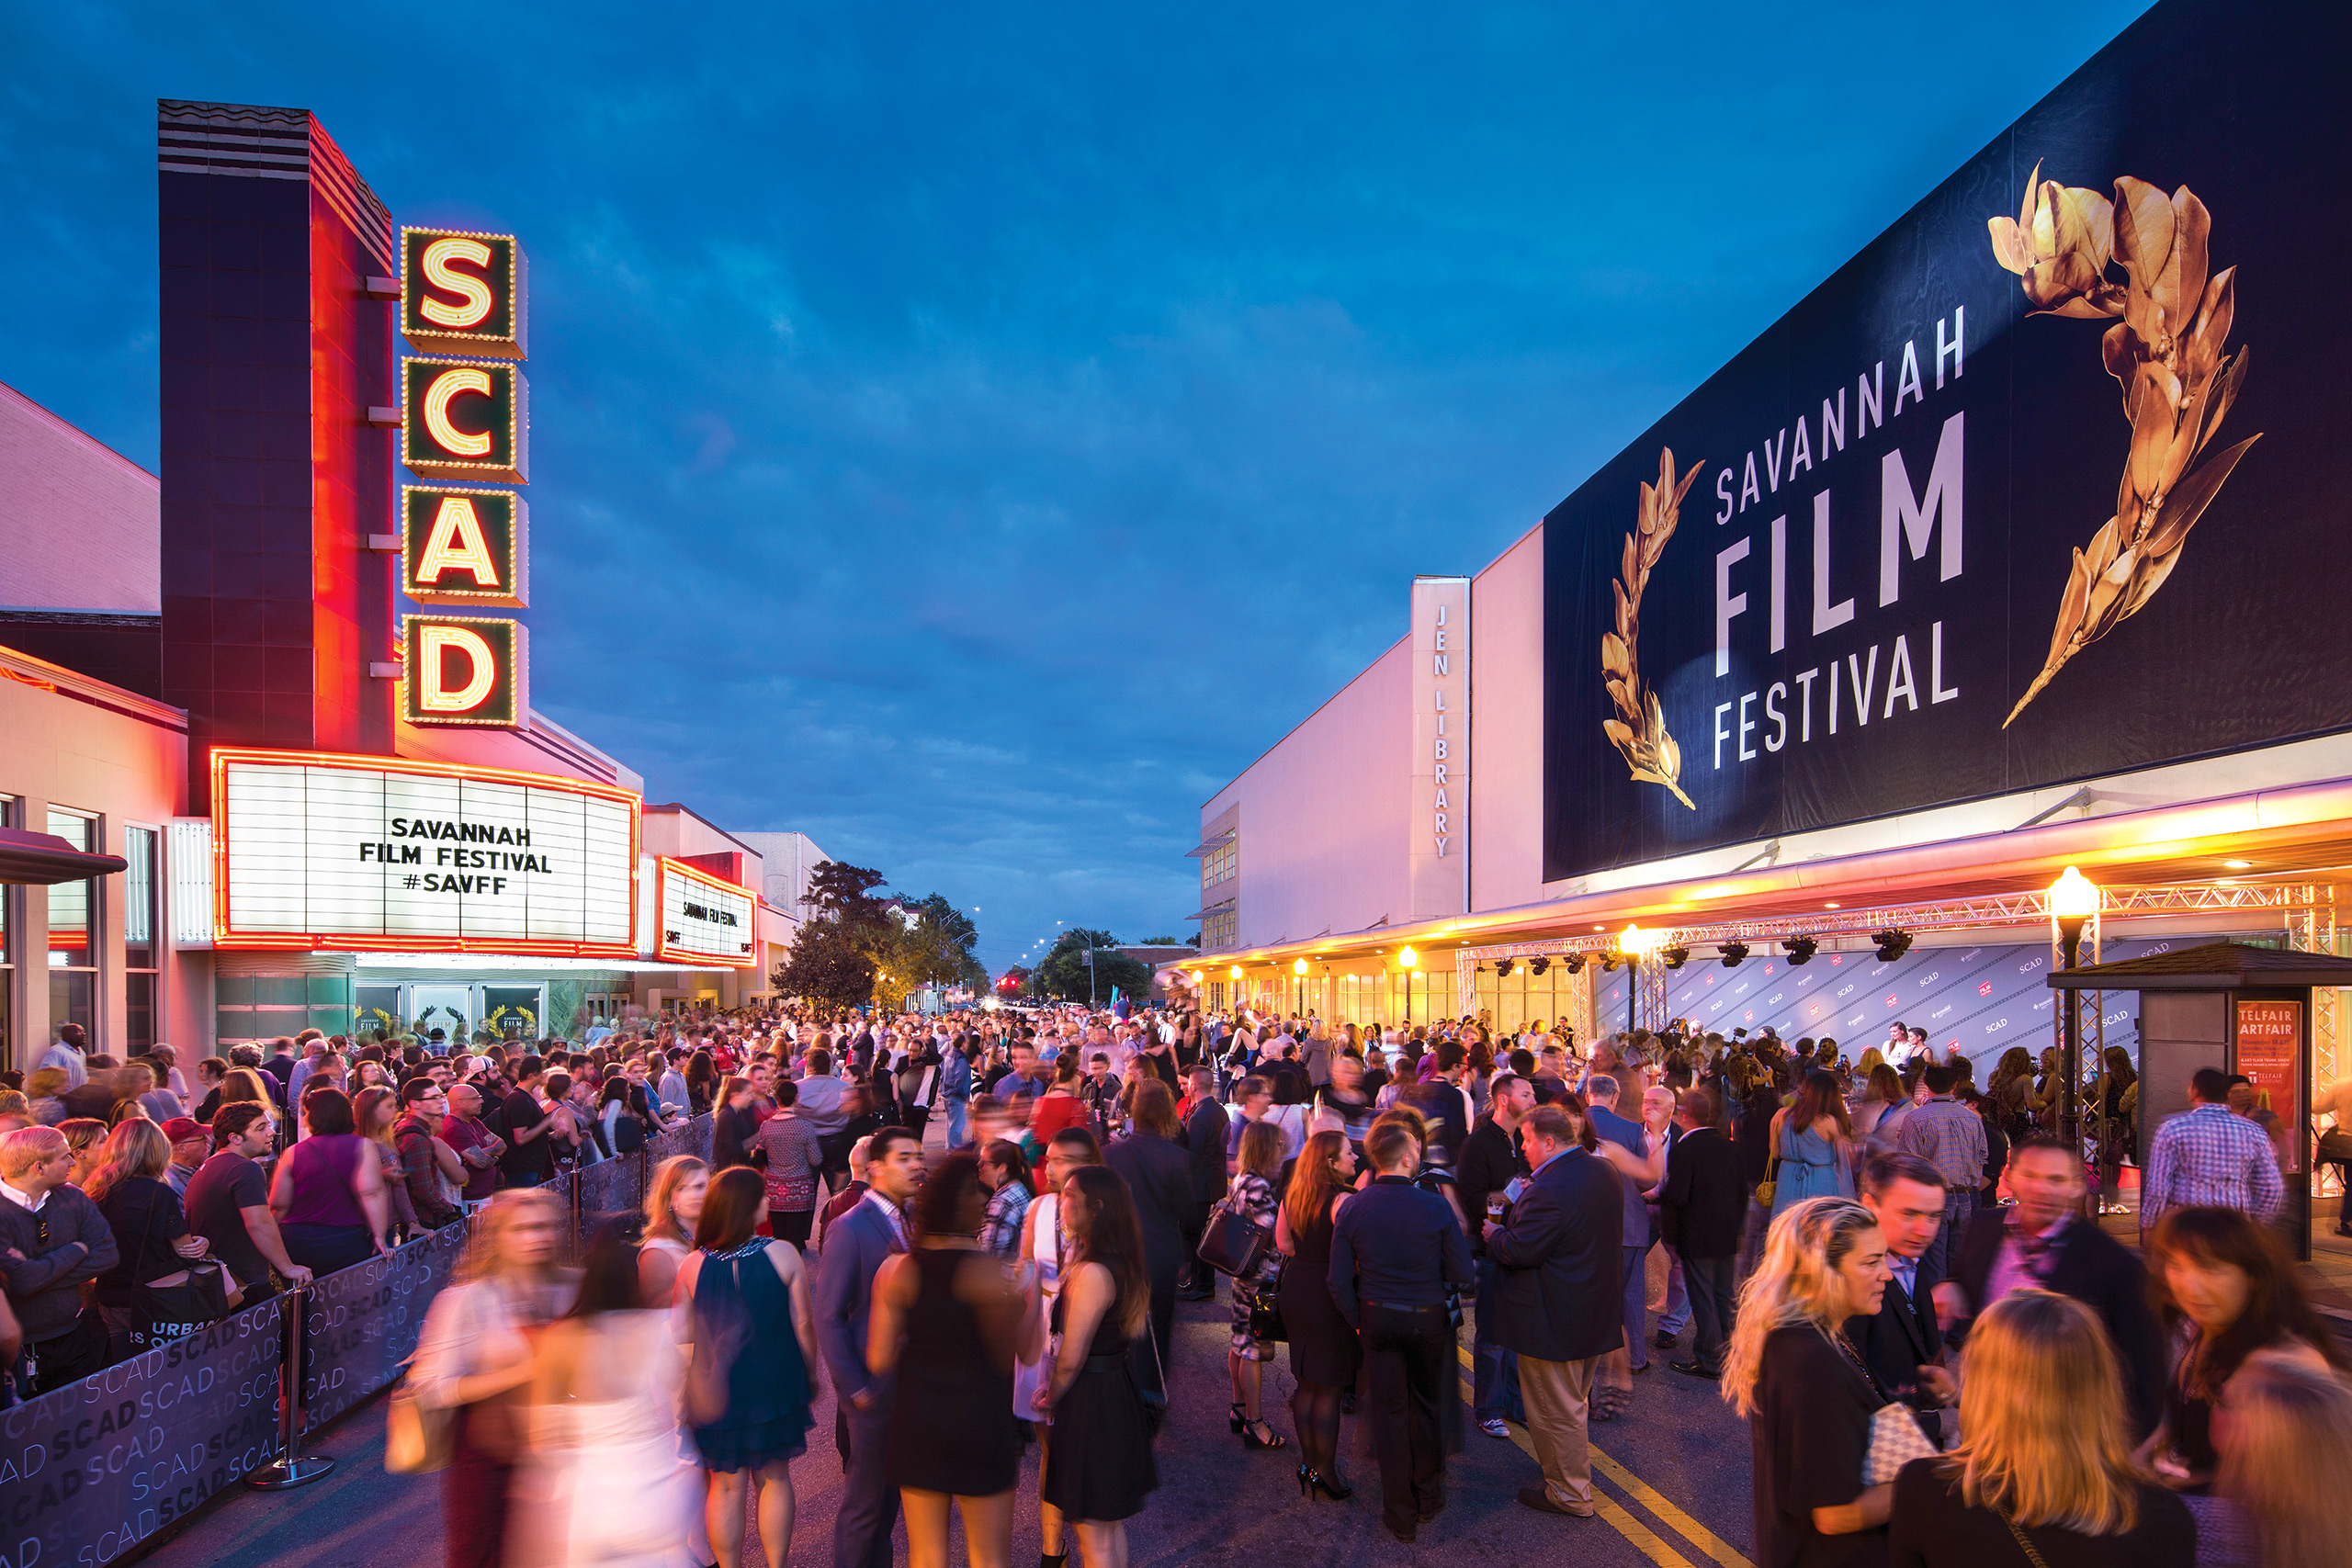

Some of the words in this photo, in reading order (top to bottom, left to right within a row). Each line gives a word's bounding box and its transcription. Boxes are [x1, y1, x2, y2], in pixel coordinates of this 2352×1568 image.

[1716, 305, 1964, 525] SAVANNAH
[415, 236, 501, 713] SCAD
[1716, 410, 1964, 677] FILM
[1434, 605, 1448, 675] JEN
[1714, 620, 1959, 771] FESTIVAL
[1434, 690, 1449, 858] LIBRARY
[391, 818, 531, 847] SAVANNAH
[359, 842, 422, 865] FILM
[436, 847, 552, 874] FESTIVAL
[402, 873, 507, 895] #SAVFF
[1919, 972, 1939, 987] SCAD
[2019, 957, 2042, 975] SCAD
[1711, 999, 1724, 1012] SCAD
[1769, 993, 1782, 1006] SCAD
[1838, 984, 1854, 998] SCAD
[503, 1021, 522, 1029] FILM
[1985, 1018, 2007, 1034] SCAD
[2101, 1010, 2128, 1028] SCAD
[2239, 1010, 2292, 1021] TELFAIR
[2240, 1024, 2264, 1035] ART
[2266, 1024, 2292, 1035] FAIR
[365, 1251, 406, 1286] SCAD
[347, 1286, 391, 1320] SCAD
[392, 1265, 432, 1301] SCAD
[362, 1305, 407, 1343] SCAD
[85, 1349, 164, 1404] SCAD
[166, 1322, 237, 1368] SCAD
[52, 1400, 136, 1461] SCAD
[140, 1366, 215, 1418] SCAD
[216, 1336, 276, 1384] SCAD
[86, 1426, 164, 1485] SCAD
[132, 1443, 205, 1501] SCAD
[78, 1508, 156, 1568] SCAD
[159, 1467, 226, 1525] SCAD
